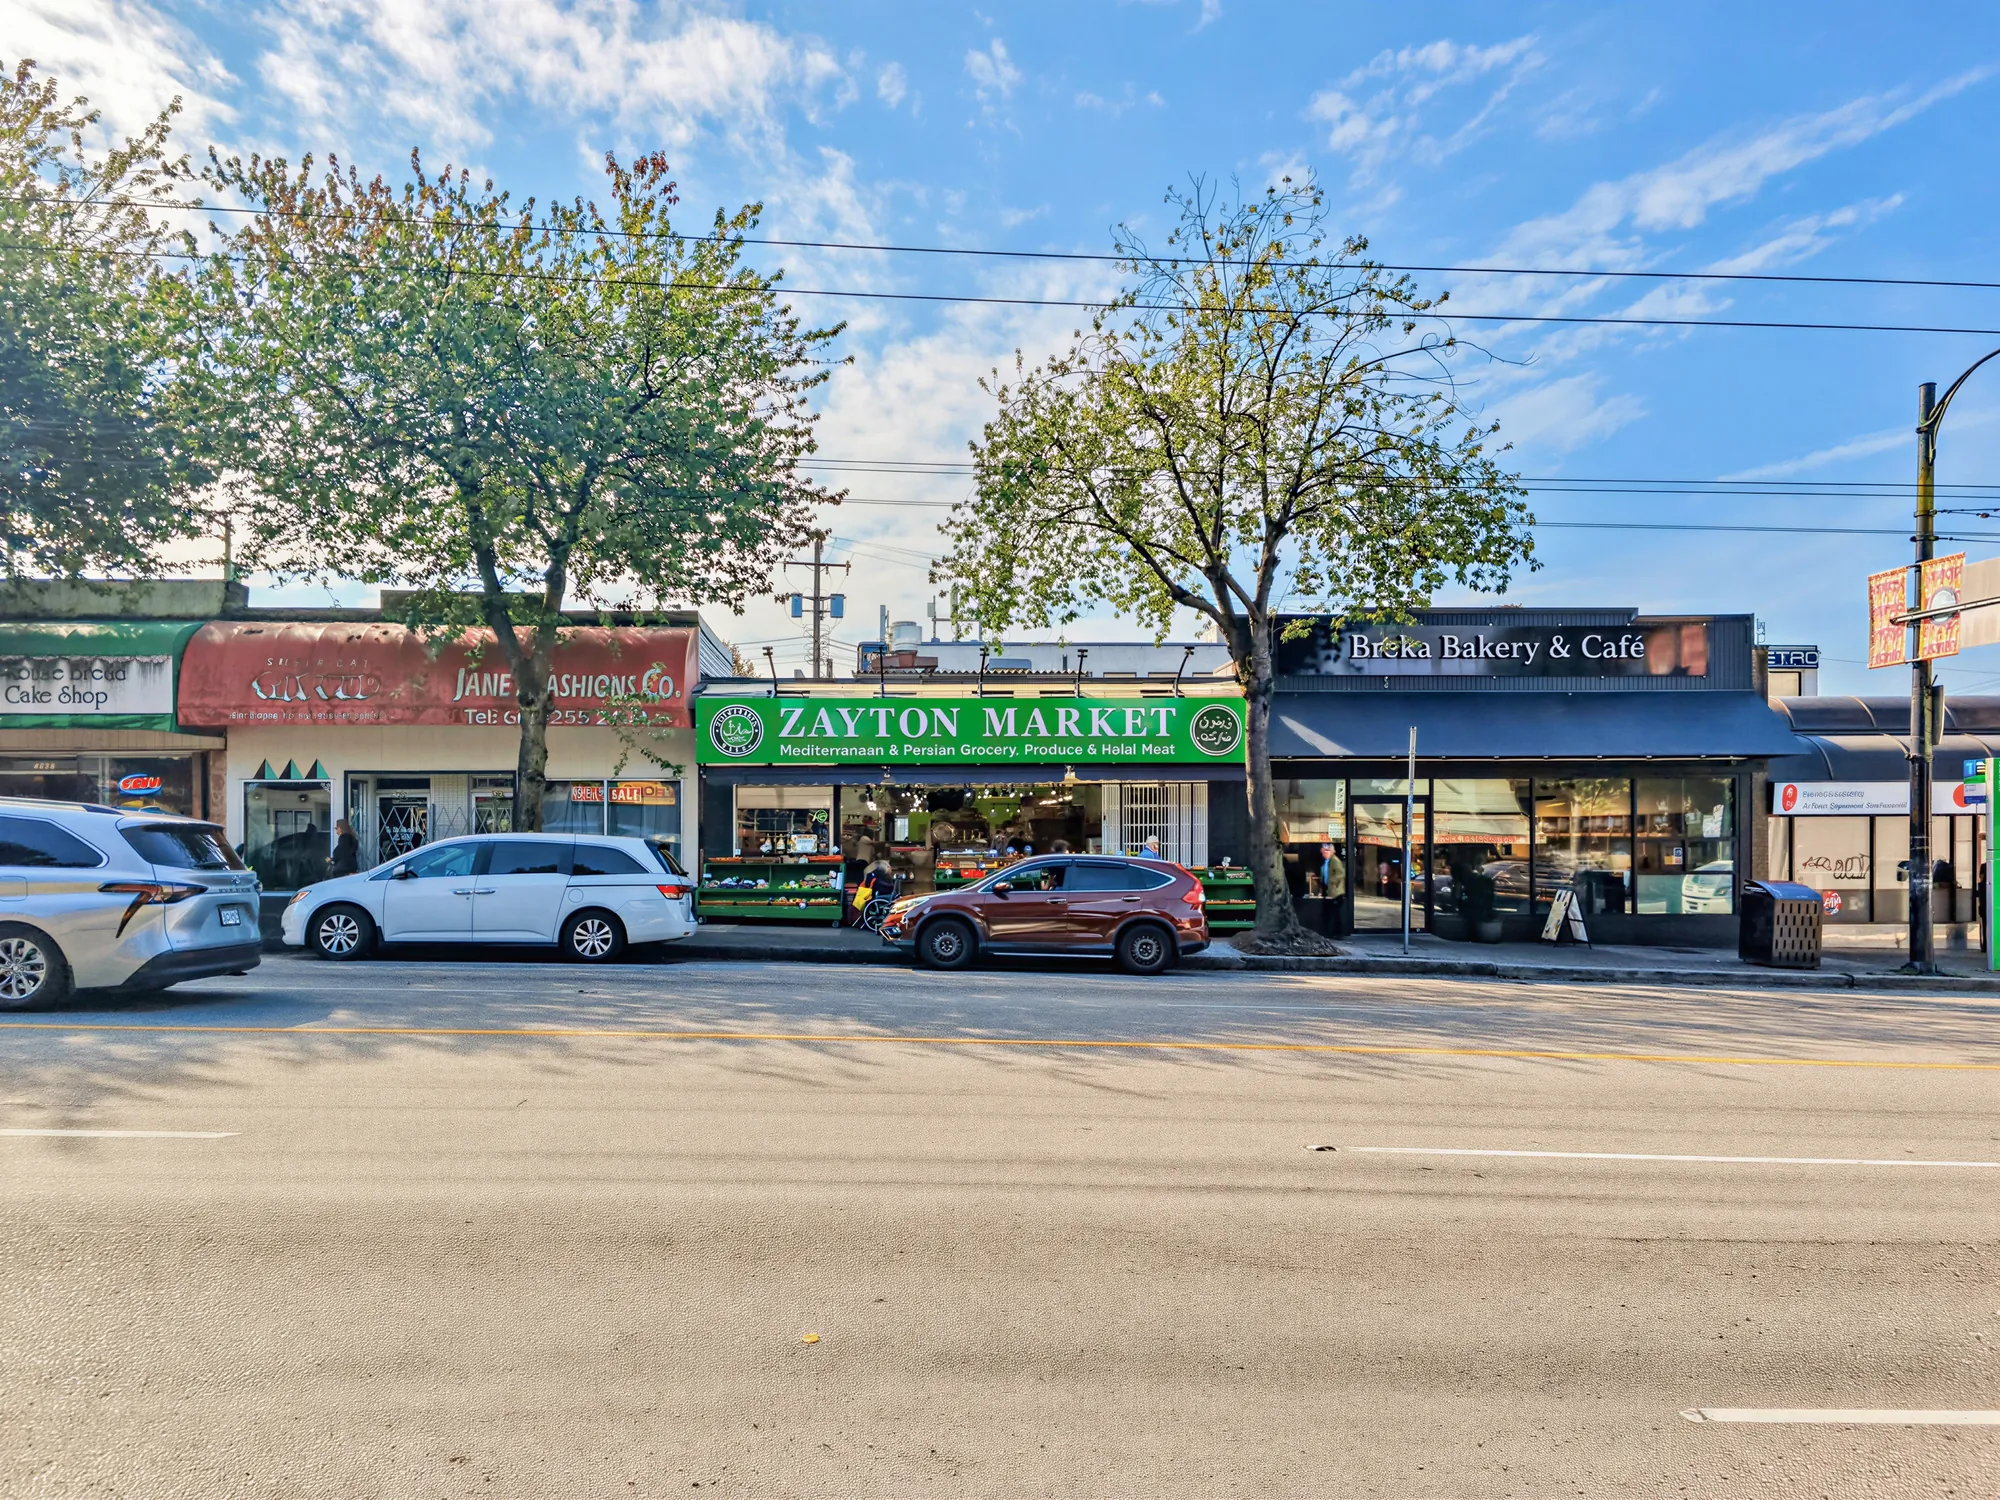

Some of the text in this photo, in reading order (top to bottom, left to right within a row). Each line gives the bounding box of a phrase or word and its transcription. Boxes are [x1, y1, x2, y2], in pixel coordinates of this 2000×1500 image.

[1442, 634, 1540, 665] Bakery
[1549, 635, 1570, 659] &
[1581, 634, 1644, 659] Café
[4, 684, 108, 710] Cake Shop
[545, 672, 637, 698] ASHIONS
[778, 707, 961, 738] ZAYTON
[982, 707, 1177, 738] MARKET
[889, 744, 899, 756] &
[903, 744, 956, 756] Persian
[1024, 743, 1083, 756] Produce
[1087, 743, 1097, 756] &
[1141, 743, 1176, 755] Meat
